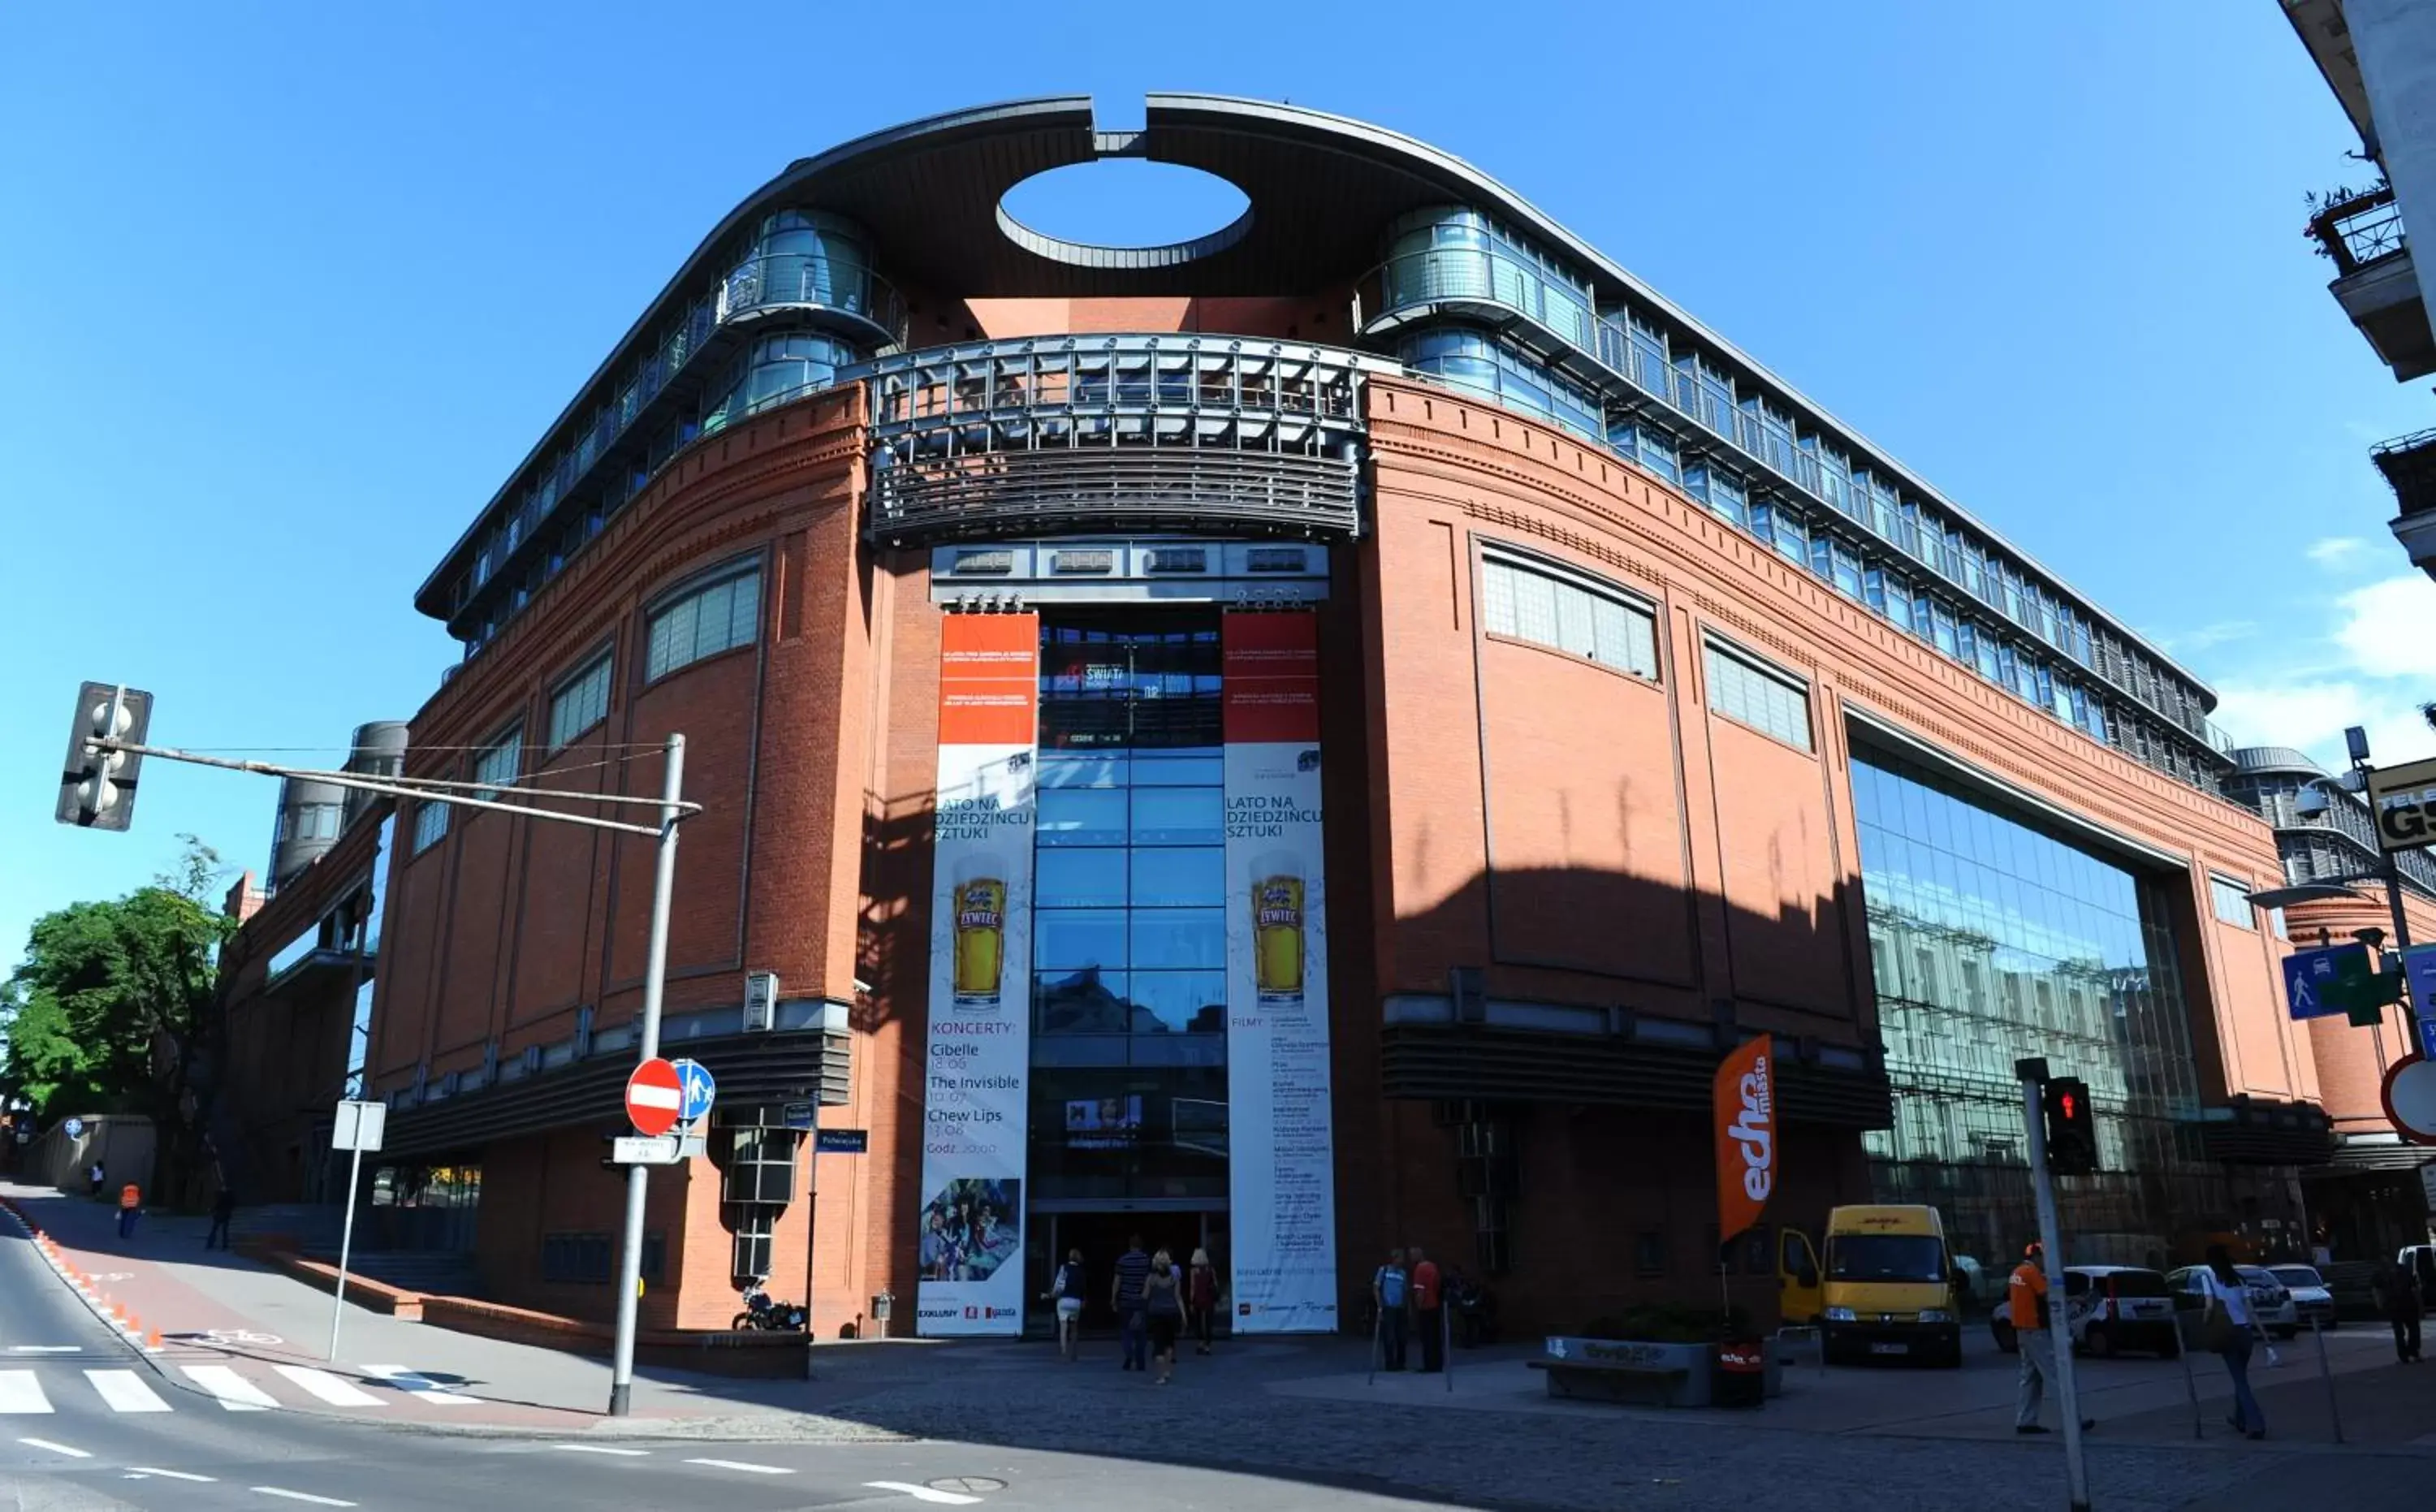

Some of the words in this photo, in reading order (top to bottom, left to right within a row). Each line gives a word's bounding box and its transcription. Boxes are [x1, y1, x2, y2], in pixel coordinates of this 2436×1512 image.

[978, 798, 1001, 810] NA
[1227, 797, 1266, 810] LATO
[1271, 796, 1295, 809] NA
[2382, 801, 2436, 840] G
[1227, 824, 1282, 838] SZTUKI
[931, 1022, 1017, 1035] KONCERTY:
[931, 1043, 979, 1056] Cibelle
[930, 1076, 957, 1089] The
[961, 1074, 1020, 1089] Invisible
[928, 1109, 970, 1122] Chew
[974, 1108, 1003, 1124] Lips
